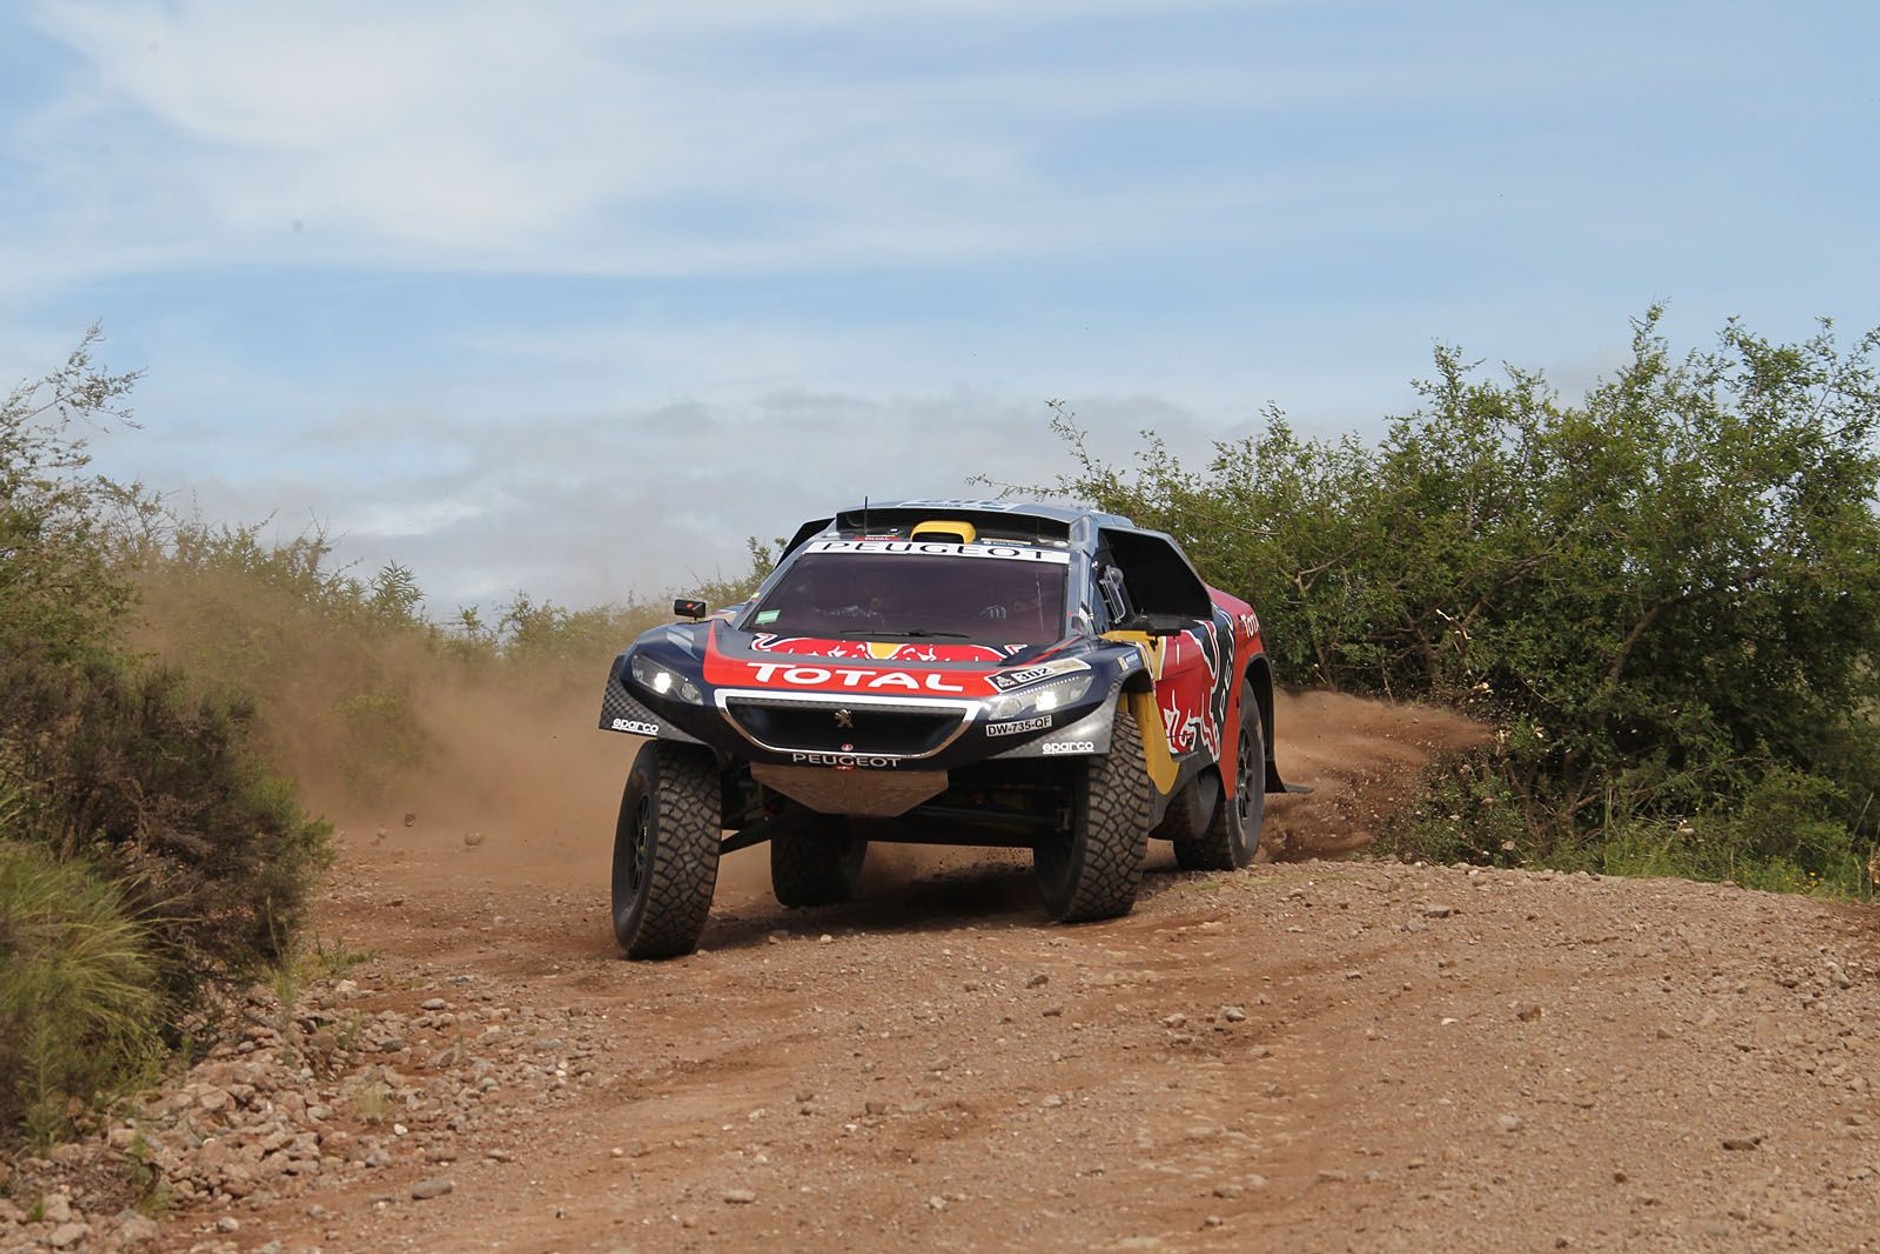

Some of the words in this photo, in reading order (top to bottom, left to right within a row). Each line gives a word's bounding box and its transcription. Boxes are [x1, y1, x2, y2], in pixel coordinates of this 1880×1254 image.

[822, 542, 1048, 560] PEUGEOT
[747, 662, 964, 692] TOTAL
[988, 716, 1051, 735] DW-735-QF
[792, 753, 902, 768] PEUGEOT
